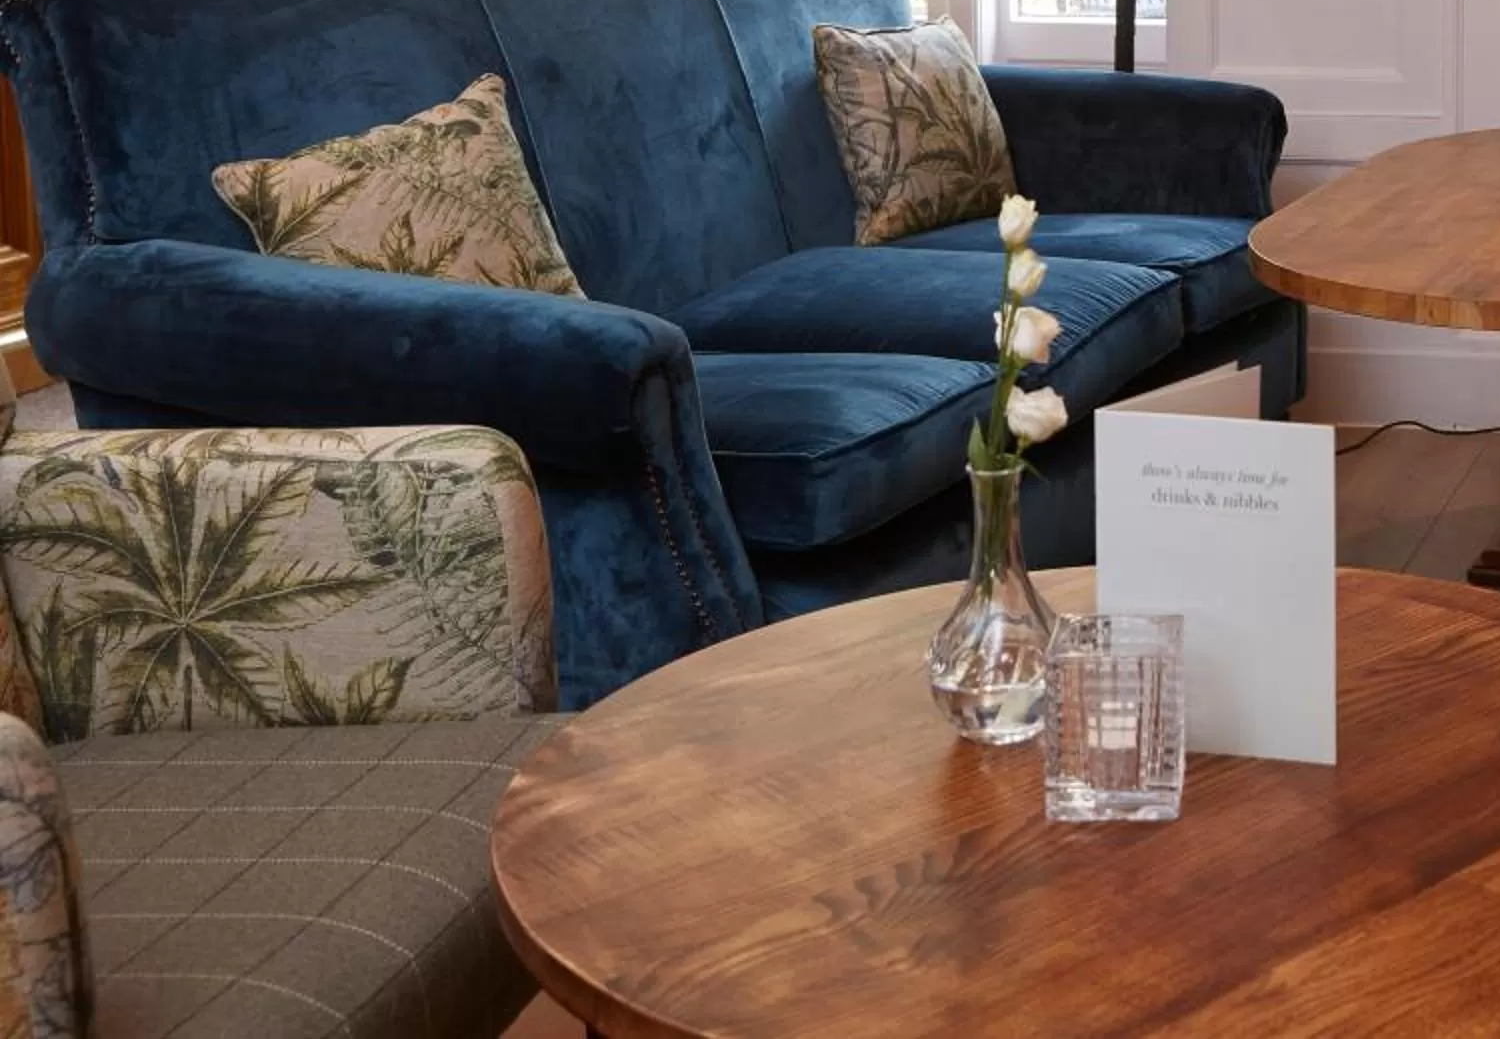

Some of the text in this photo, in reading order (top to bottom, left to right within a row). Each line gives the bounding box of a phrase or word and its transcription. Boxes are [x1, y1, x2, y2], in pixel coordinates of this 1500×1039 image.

[1186, 464, 1235, 485] always
[1151, 486, 1280, 512] drinks & nibbles
